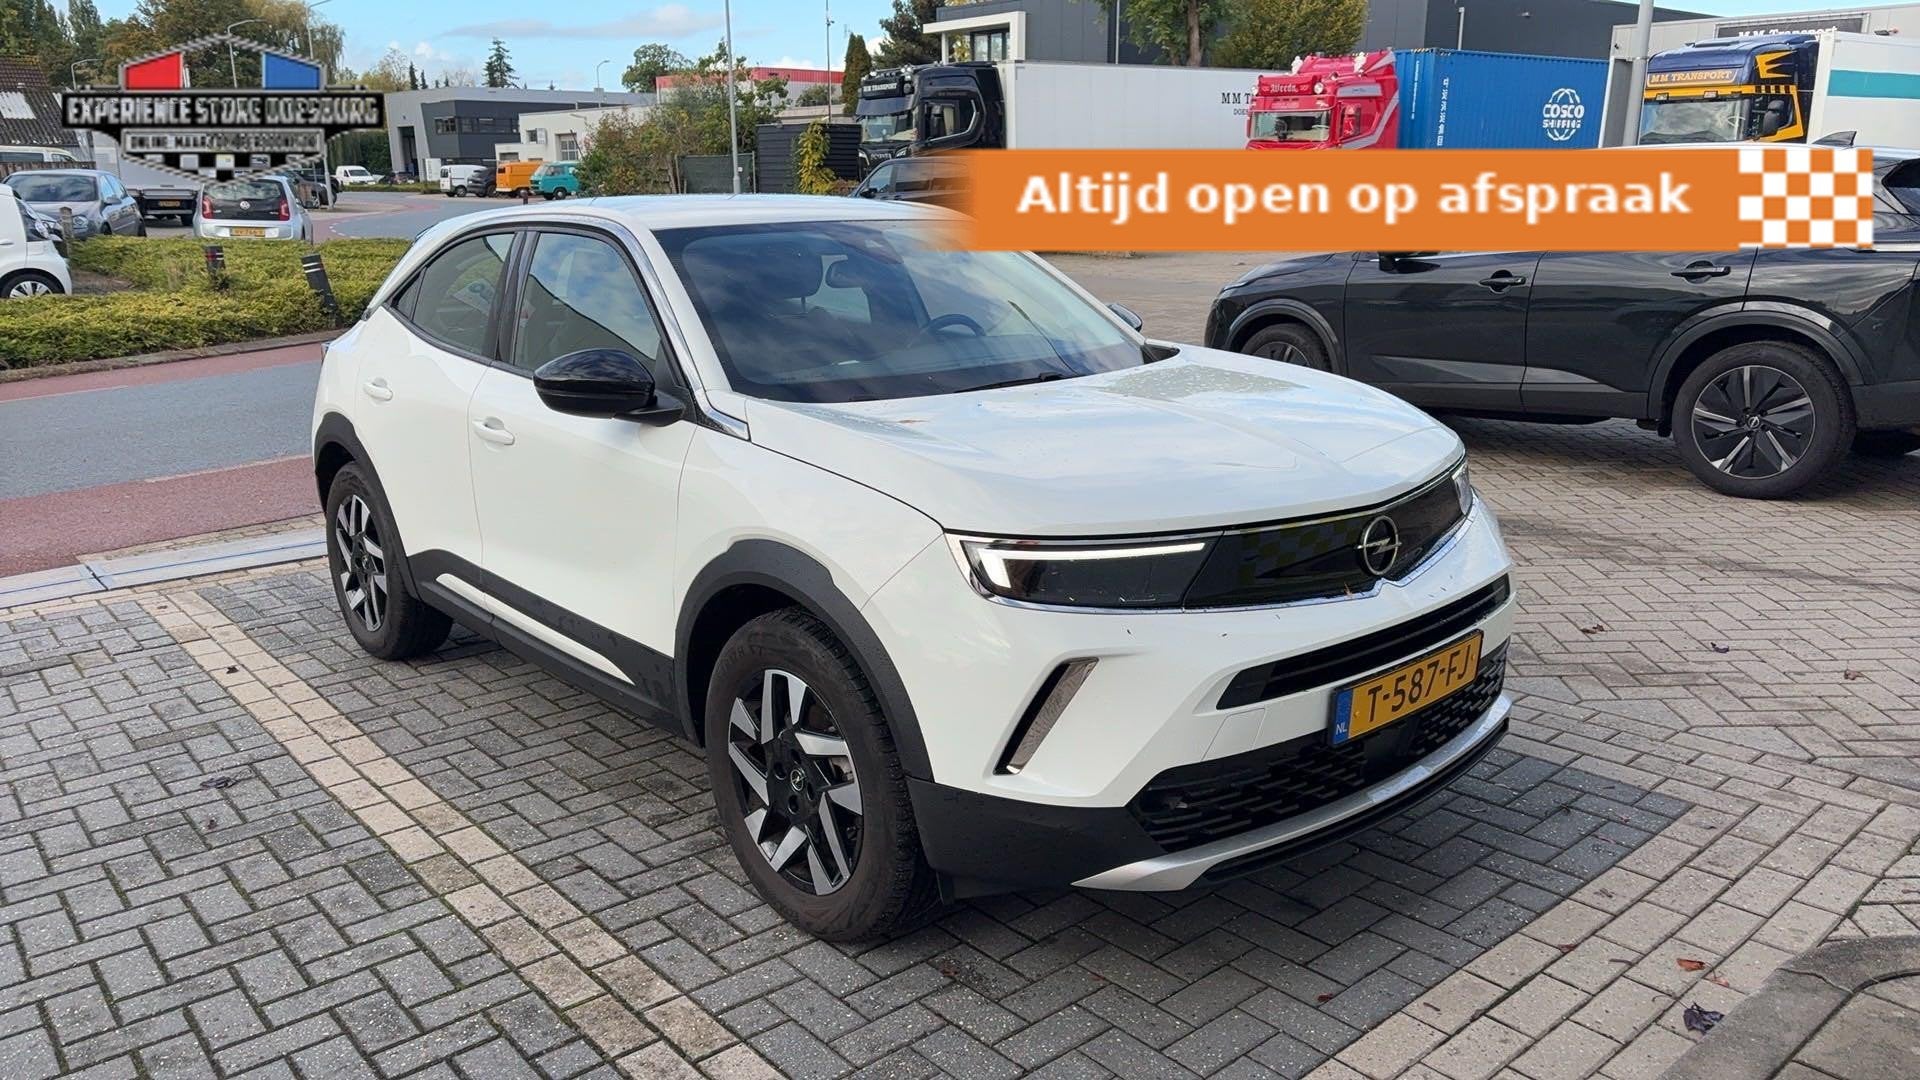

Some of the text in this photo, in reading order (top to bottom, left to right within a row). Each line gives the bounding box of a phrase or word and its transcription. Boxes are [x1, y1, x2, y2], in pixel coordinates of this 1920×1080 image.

[1651, 70, 1732, 83] MM TRANSPORT
[1543, 104, 1585, 118] COSCO
[1367, 644, 1472, 723] T-587-FJ
[1335, 722, 1348, 736] NL
